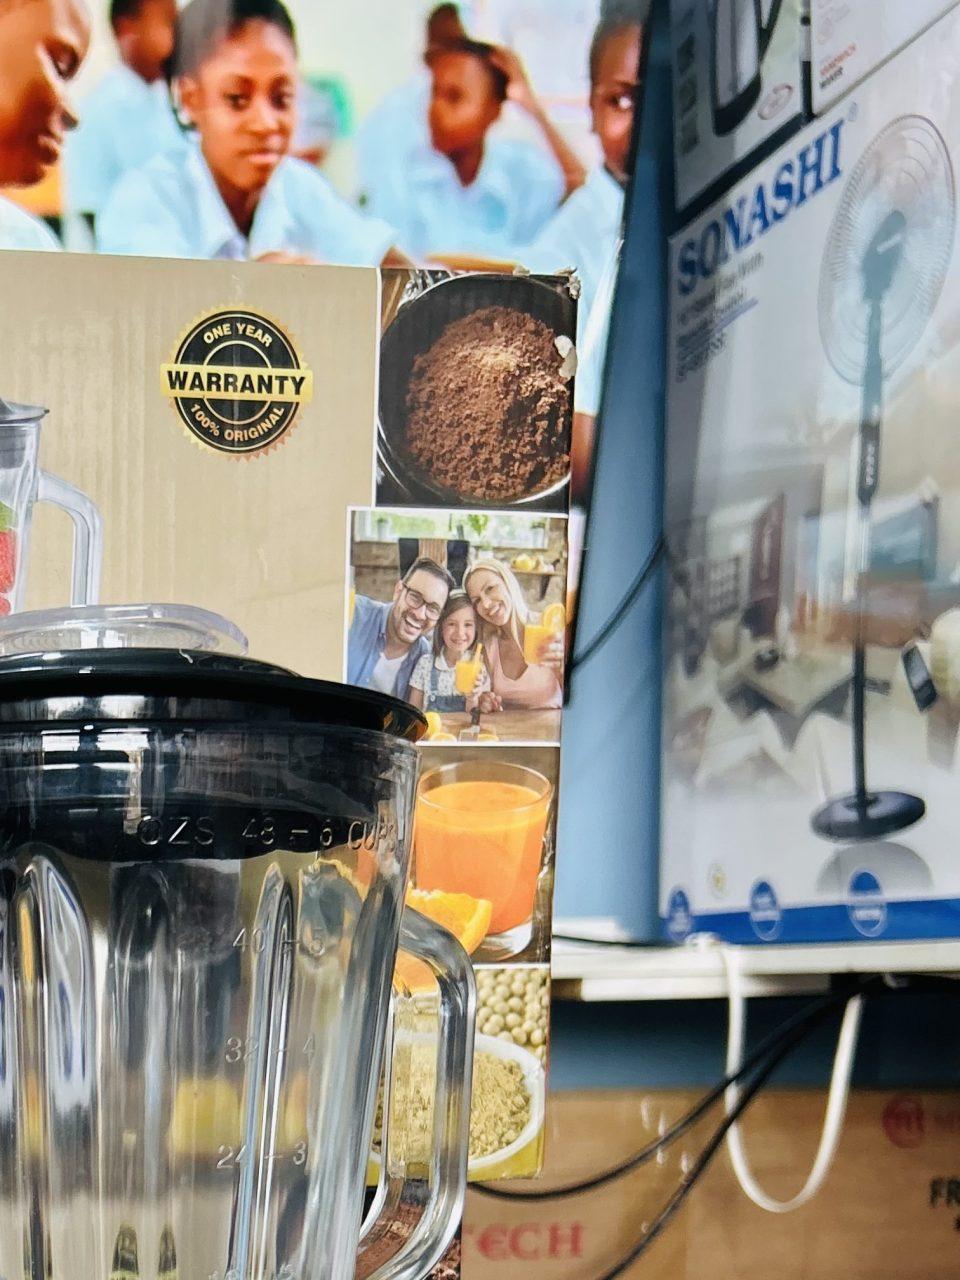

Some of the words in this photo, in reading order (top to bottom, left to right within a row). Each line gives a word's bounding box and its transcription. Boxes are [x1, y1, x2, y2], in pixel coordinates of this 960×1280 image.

[677, 117, 845, 295] SONASHI
[203, 323, 232, 344] ONE
[236, 322, 273, 347] YEAR
[167, 370, 306, 395] WARRANTY
[191, 403, 220, 436] 100%
[224, 407, 284, 441] ORIGINAL
[140, 815, 215, 846] OZS
